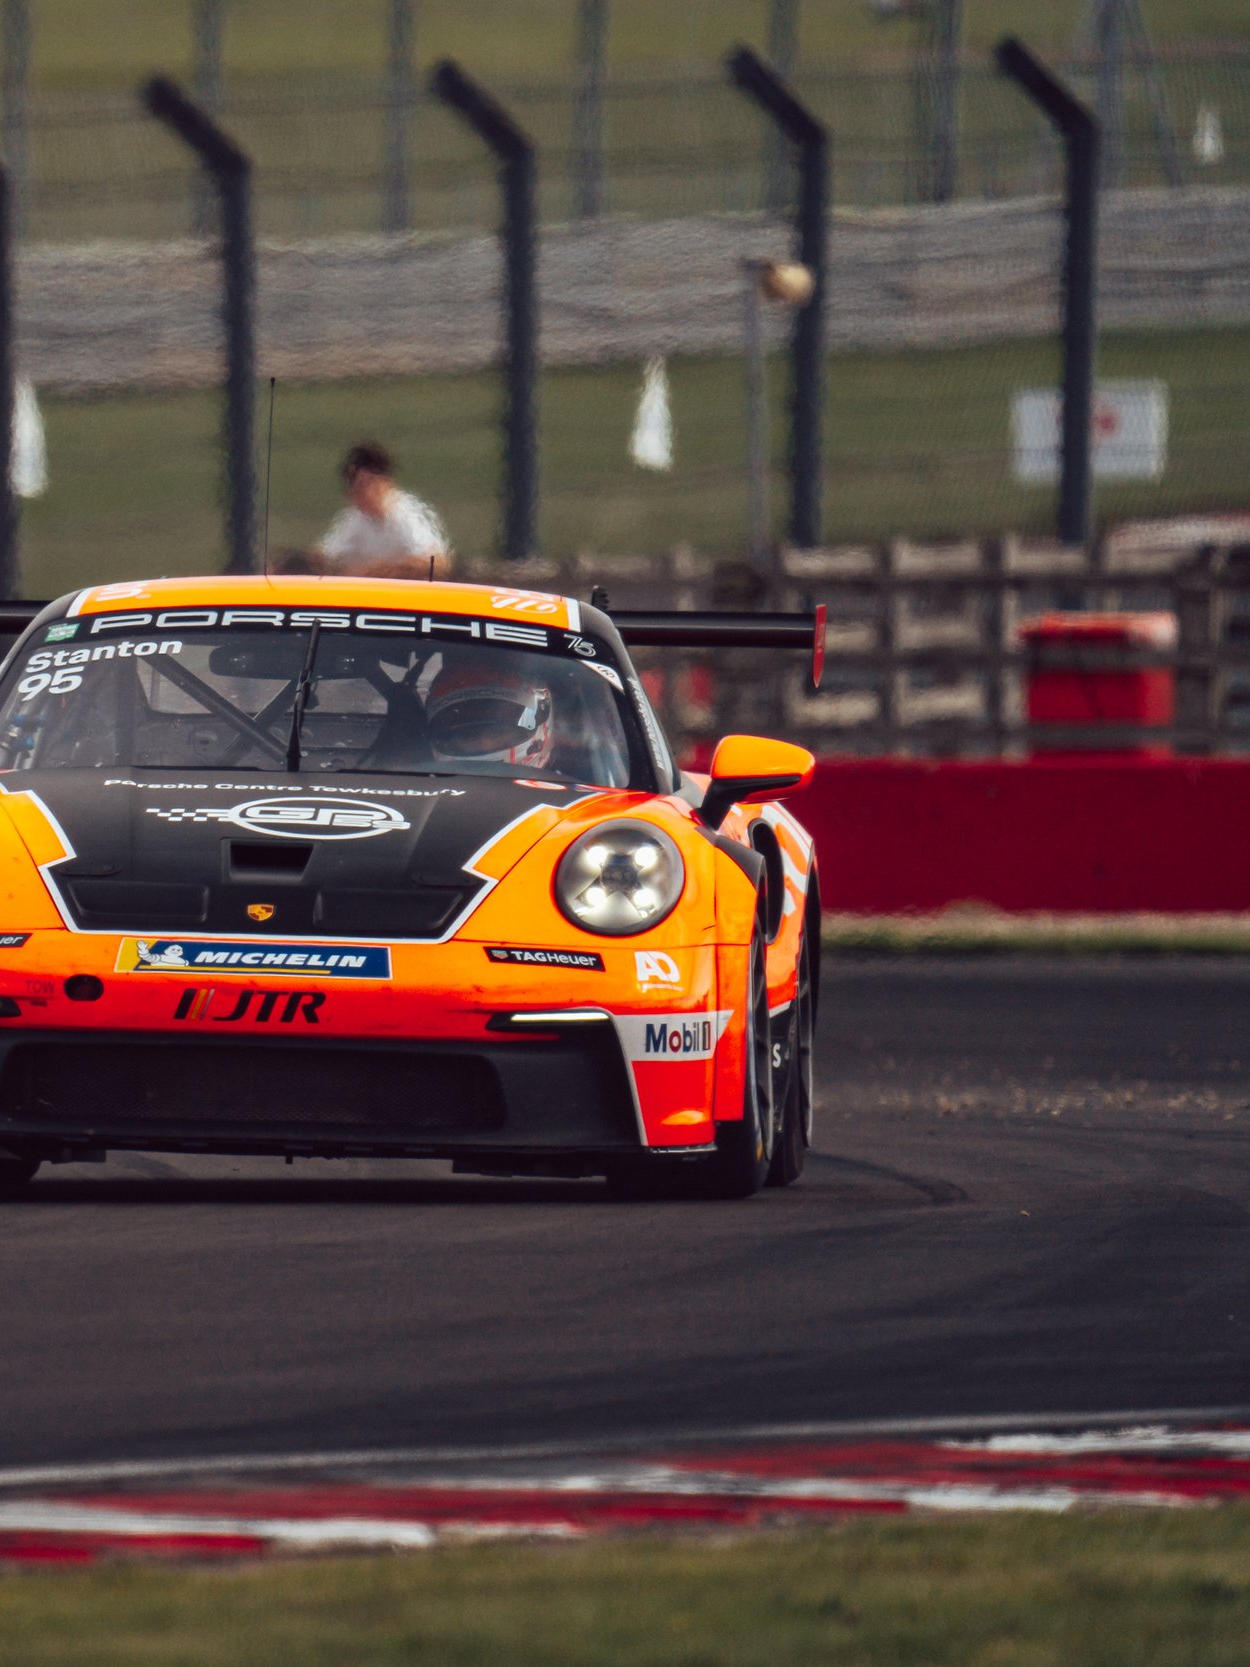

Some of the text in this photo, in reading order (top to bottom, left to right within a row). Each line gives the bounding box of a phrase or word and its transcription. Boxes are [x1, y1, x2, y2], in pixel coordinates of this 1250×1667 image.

[90, 611, 548, 647] PORSCHE
[25, 640, 183, 673] Stanton
[18, 665, 85, 701] 95
[104, 779, 466, 796] Porsche Centre Tewkesbury
[194, 950, 368, 968] MICHELIN
[212, 990, 327, 1023] JTR
[645, 1022, 700, 1053] Mobil
